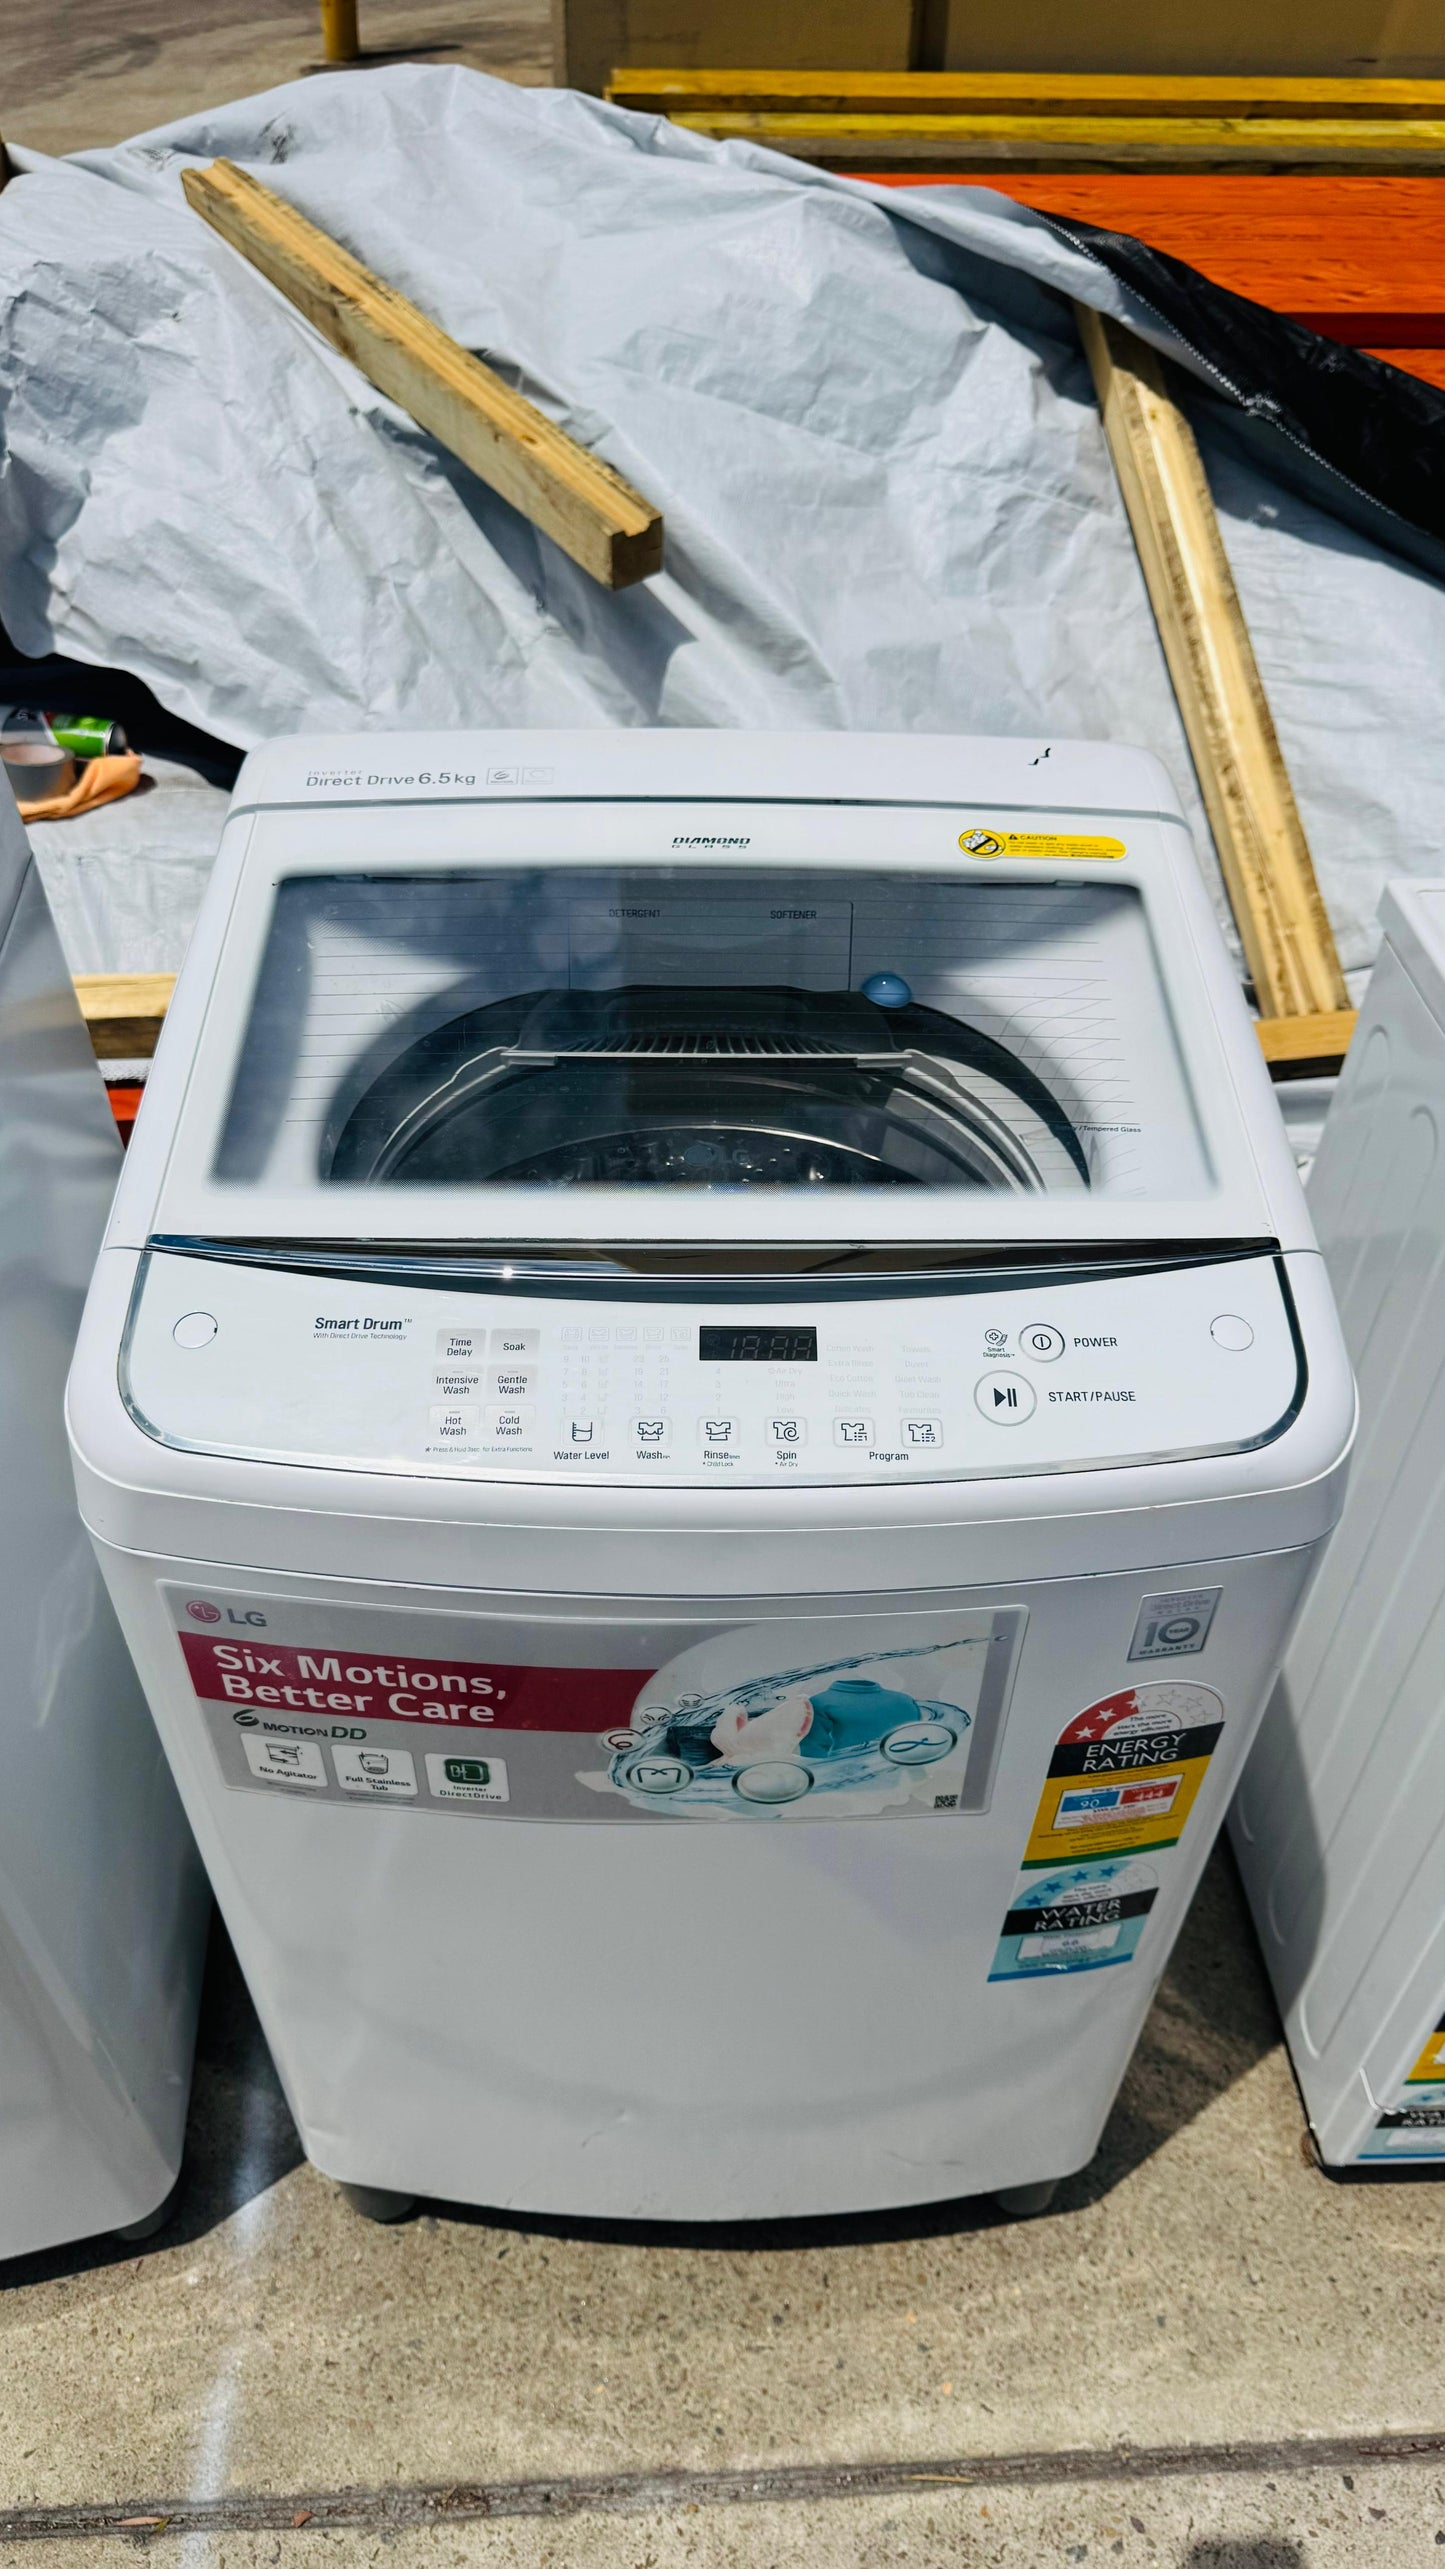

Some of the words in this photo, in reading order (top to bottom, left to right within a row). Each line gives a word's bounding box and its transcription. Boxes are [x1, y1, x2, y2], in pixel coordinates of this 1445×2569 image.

[306, 776, 363, 787] Direct
[367, 775, 415, 786] Drive
[418, 772, 451, 785] 6.5
[454, 773, 476, 786] kg
[672, 837, 751, 845] DIAMOND
[608, 908, 661, 918] DETERGENT
[770, 910, 817, 919] SOFTENER
[314, 1316, 360, 1330] Smart
[370, 1333, 407, 1341] Technology
[1073, 1337, 1118, 1347] POWER
[450, 1338, 472, 1347] Time
[503, 1342, 526, 1351] Soak
[446, 1348, 472, 1357] Delay
[436, 1375, 479, 1385] Intensive
[497, 1375, 528, 1384] Gentle
[443, 1385, 470, 1394] Wash
[498, 1385, 526, 1394] Wash
[1048, 1391, 1137, 1402] START/PAUSE
[445, 1415, 462, 1425] Hot
[499, 1415, 520, 1425] Cold
[440, 1426, 467, 1435] Wash
[496, 1426, 523, 1435] Wash
[553, 1450, 582, 1460] Water
[584, 1451, 610, 1460] Level
[636, 1450, 662, 1460] Wash
[703, 1450, 729, 1460] Rinse
[776, 1450, 797, 1460] Spin
[869, 1451, 909, 1462] Program
[227, 1608, 268, 1627] LG
[1143, 1617, 1200, 1647] 10
[1139, 1643, 1195, 1655] WARRANTY
[212, 1644, 285, 1677] Six
[296, 1655, 507, 1700] Motions,
[221, 1673, 373, 1712] Better
[388, 1692, 495, 1723] Care
[1086, 1732, 1187, 1758] ENERGY
[1082, 1748, 1180, 1773] RATING
[259, 1766, 274, 1774] No
[276, 1768, 317, 1780] Agitator
[345, 1775, 364, 1783] Full
[365, 1777, 411, 1787] Stainless
[1080, 1798, 1100, 1809] 90
[1041, 1898, 1122, 1920] WATER
[1033, 1909, 1121, 1932] RATING
